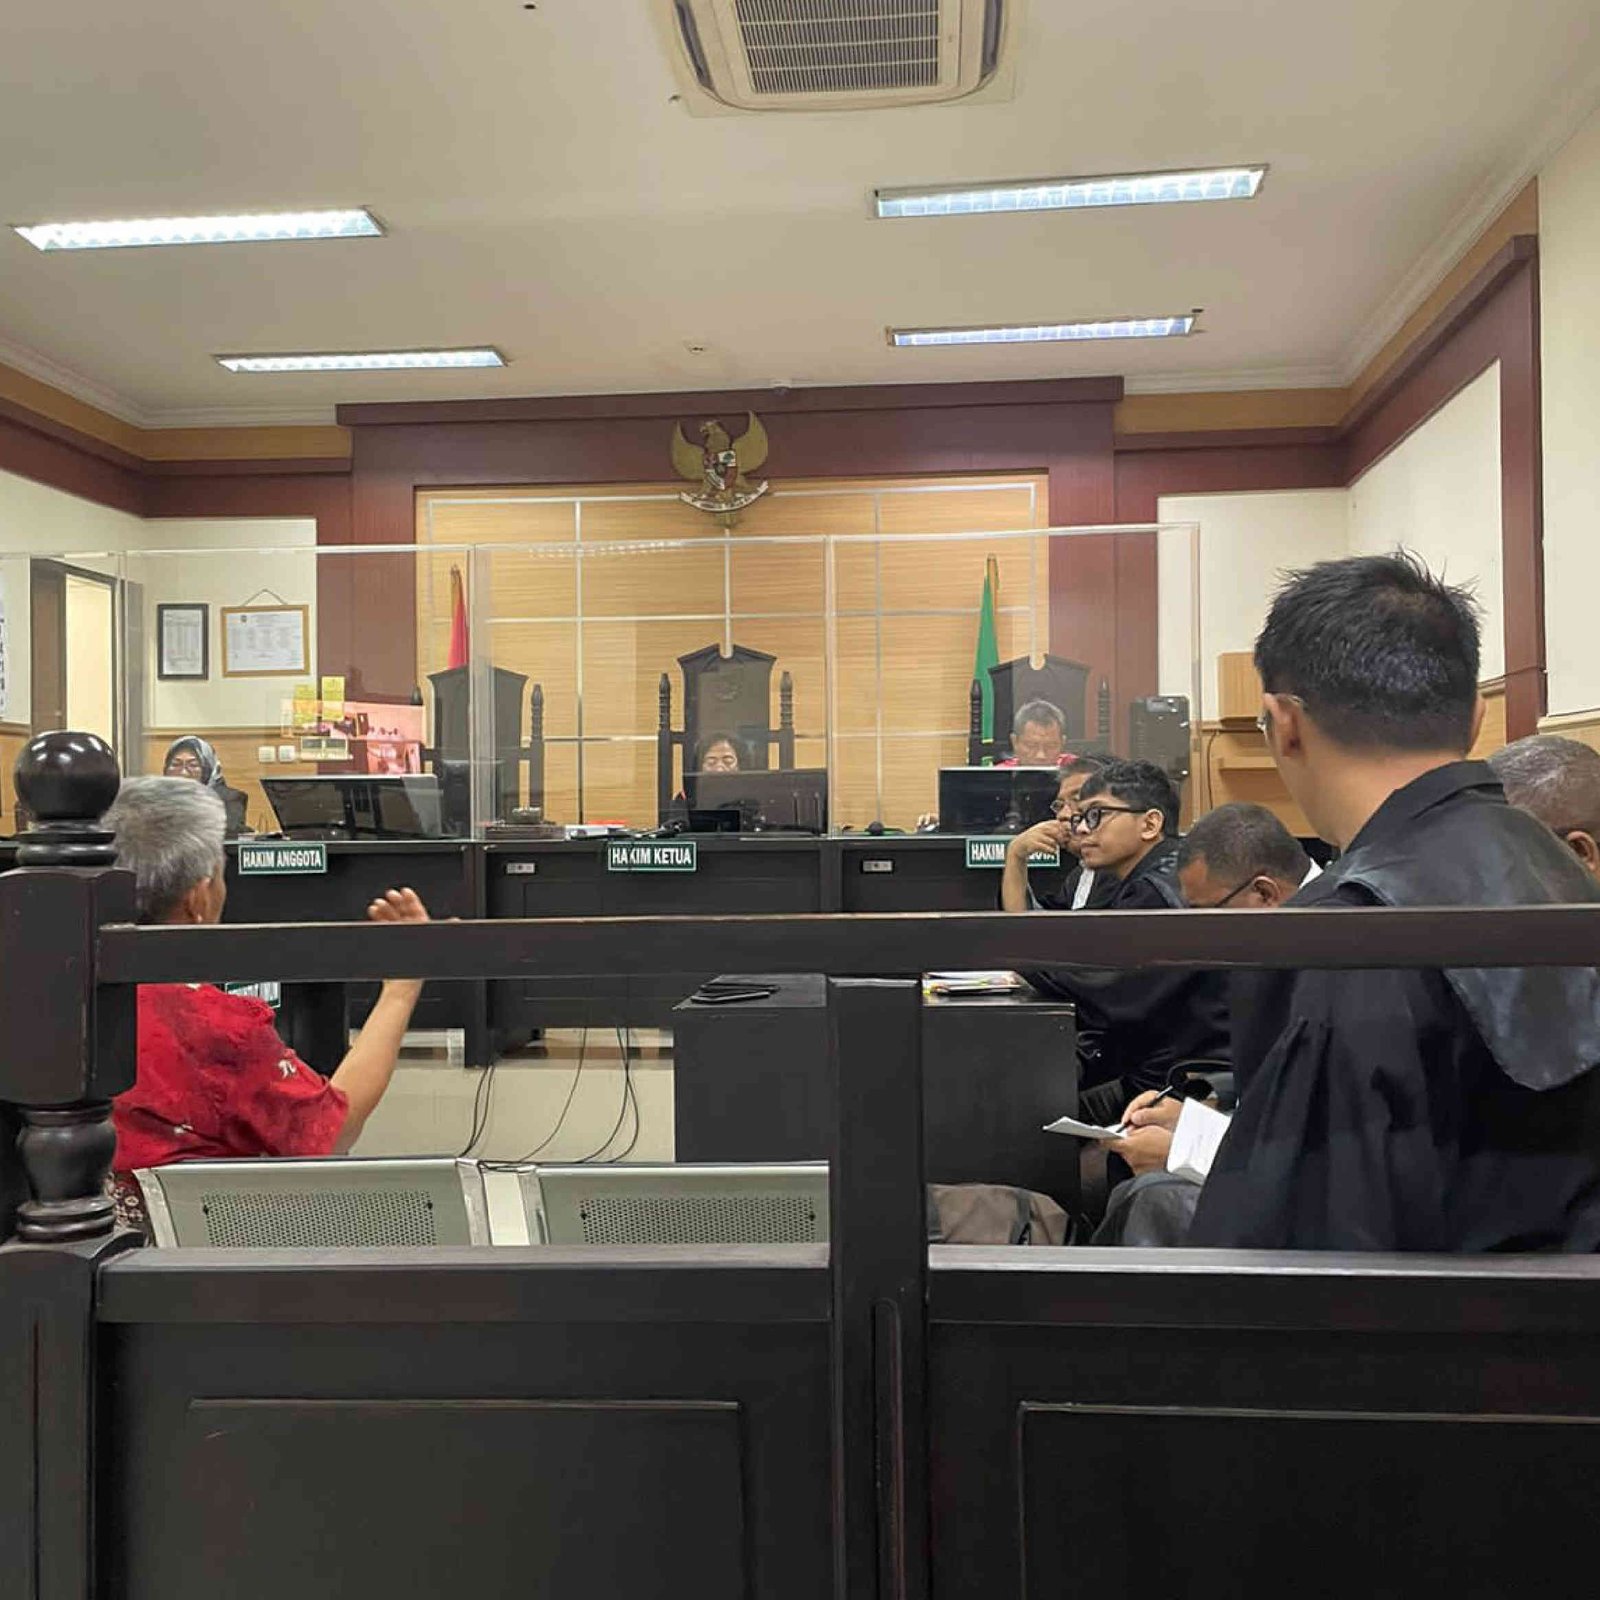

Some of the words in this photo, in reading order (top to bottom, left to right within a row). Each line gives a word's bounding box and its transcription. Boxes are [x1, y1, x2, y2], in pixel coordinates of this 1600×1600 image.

[243, 851, 274, 867] HAKIM
[277, 850, 321, 866] ANGGOTA
[612, 848, 651, 864] HAKIM
[654, 847, 691, 863] KETUA
[972, 843, 1005, 860] HAKIM
